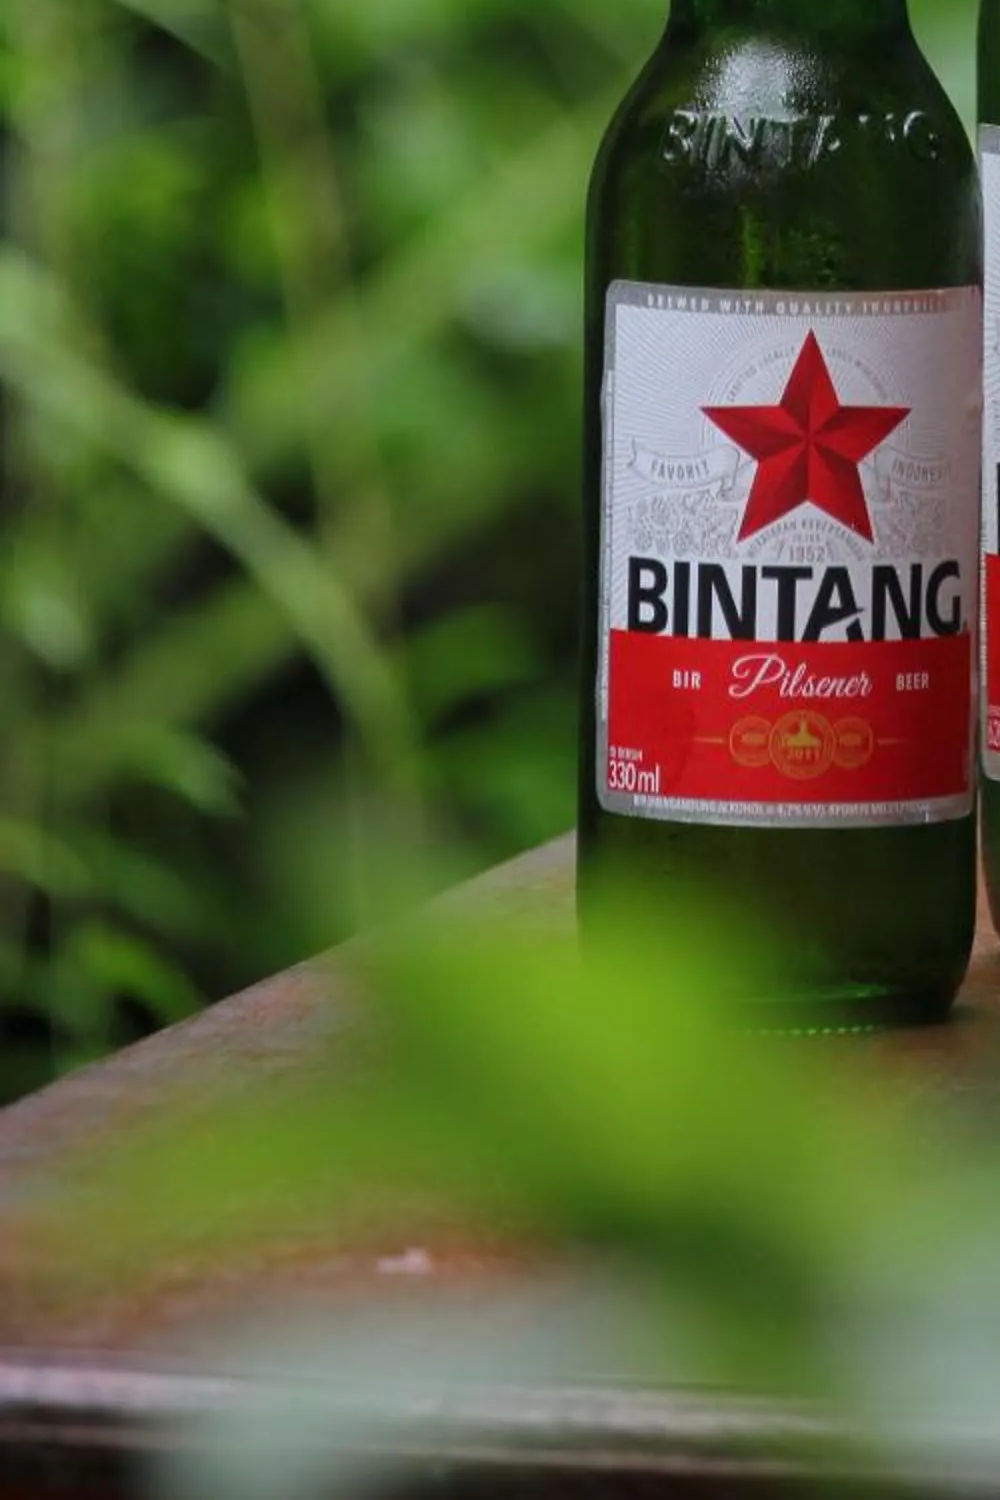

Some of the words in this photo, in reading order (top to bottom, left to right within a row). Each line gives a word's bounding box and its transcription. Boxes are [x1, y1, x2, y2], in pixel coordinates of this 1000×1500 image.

[719, 298, 765, 314] WITH
[776, 300, 852, 315] QUALITY
[651, 459, 710, 481] FAVORIT
[628, 556, 961, 642] BINTANG
[672, 669, 702, 689] BIR
[728, 653, 873, 699] Pilsener
[895, 671, 930, 691] BEER
[609, 760, 660, 793] 330ml
